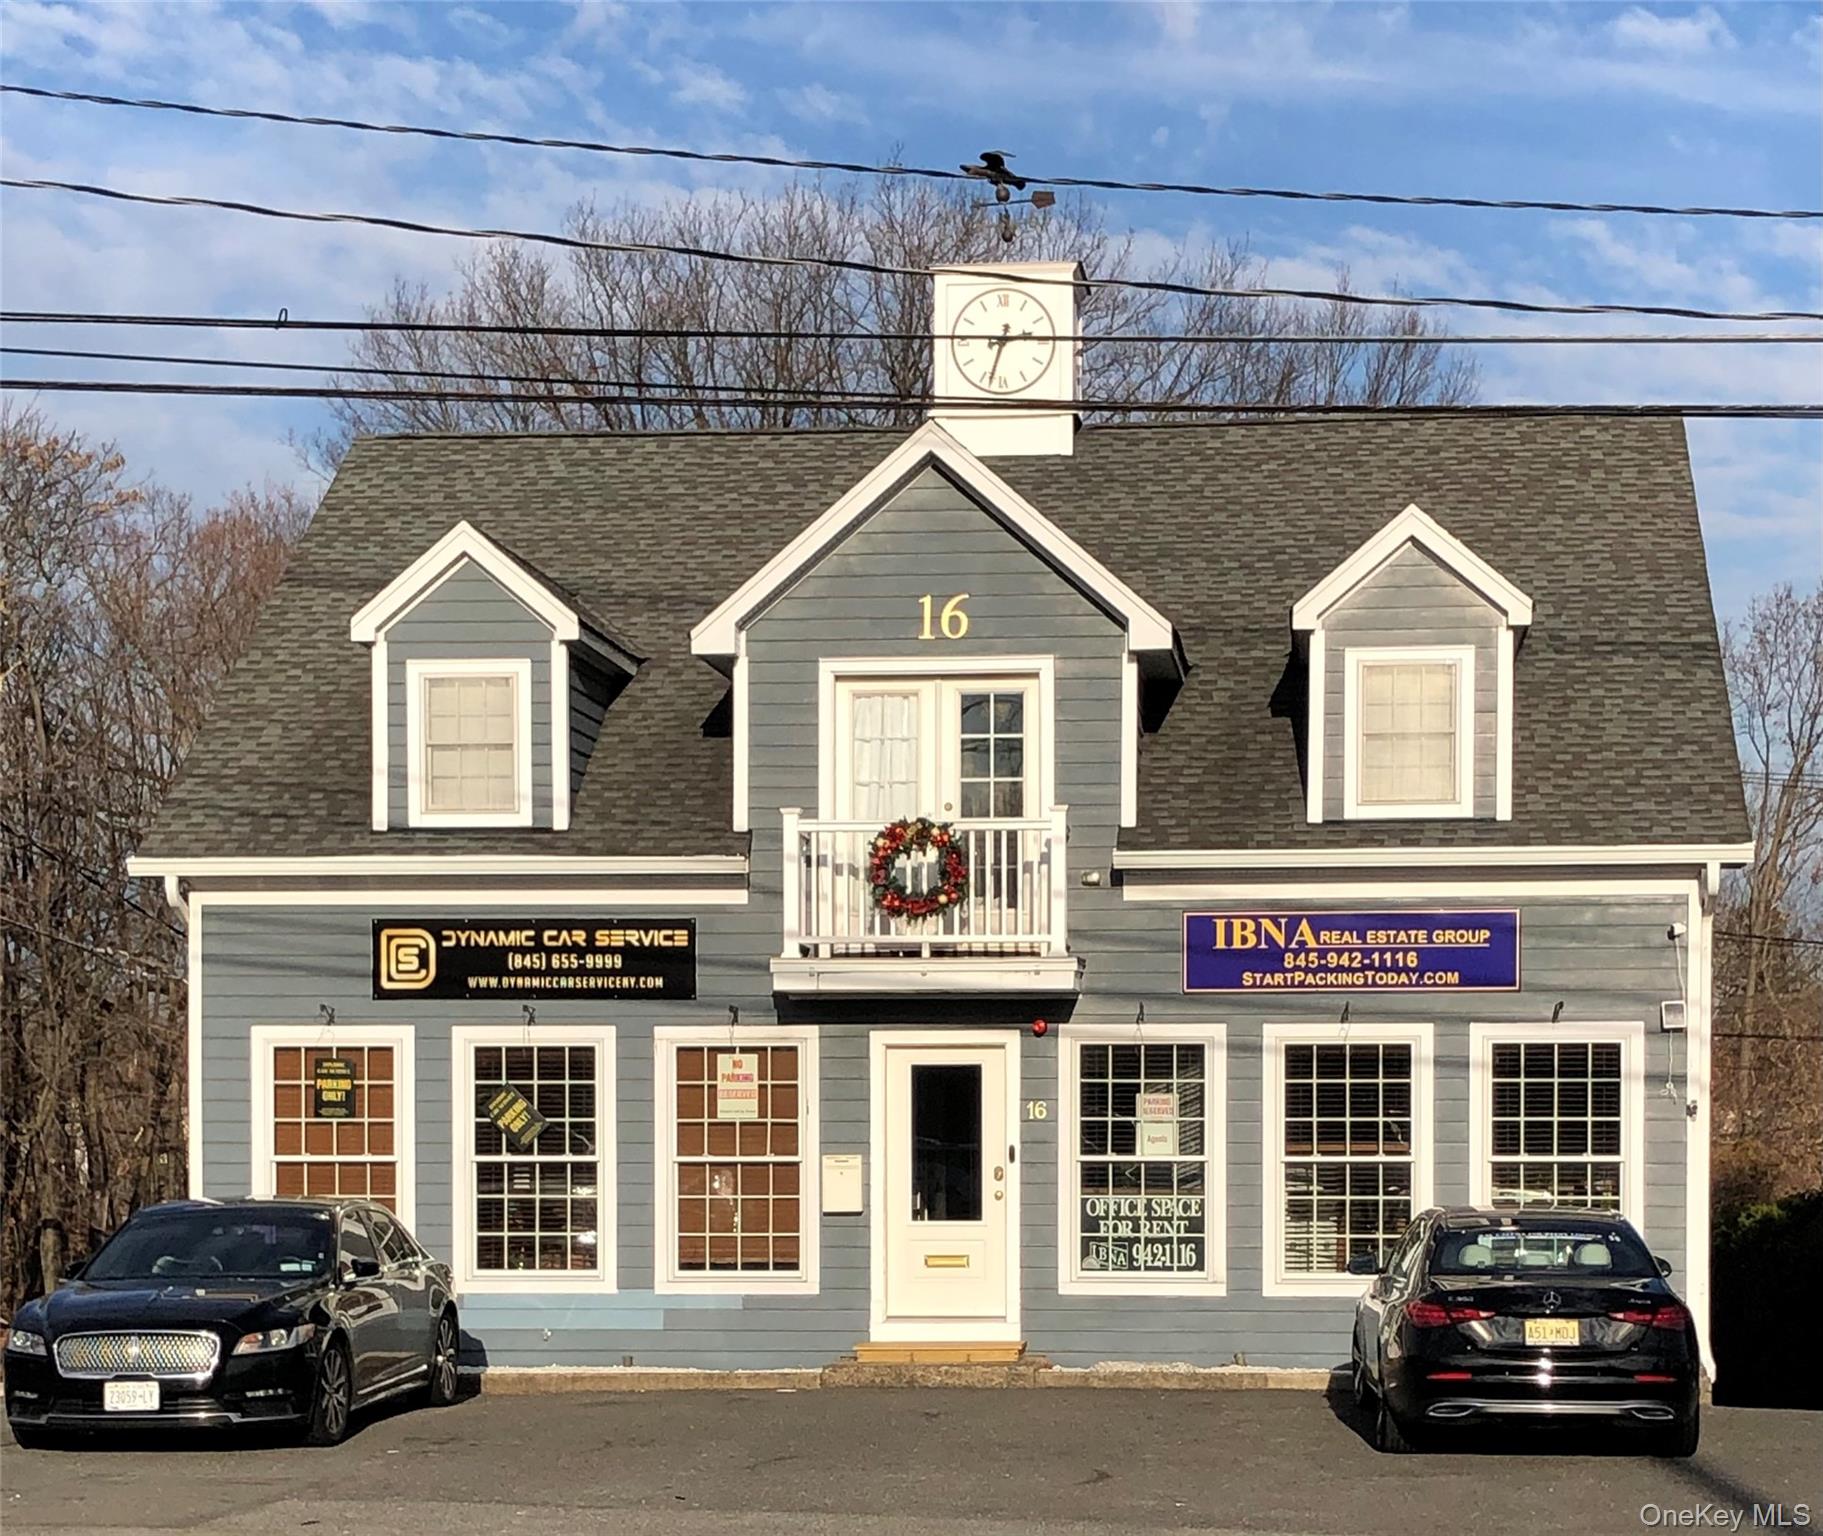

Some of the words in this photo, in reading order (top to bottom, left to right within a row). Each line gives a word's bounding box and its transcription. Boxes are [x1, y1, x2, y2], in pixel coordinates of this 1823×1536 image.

[918, 594, 970, 640] 16
[441, 929, 536, 947] DYNAMIC
[543, 929, 587, 947] CAR
[594, 929, 689, 947] SERVICE
[1211, 918, 1320, 950] IBNA
[1320, 931, 1358, 944] REAL
[1366, 930, 1426, 944] ESTATE
[1432, 929, 1491, 943] GROUP
[508, 952, 547, 971] (845)
[551, 953, 623, 969] 655-9999
[1284, 951, 1418, 969] 845-942-1116
[732, 1059, 743, 1069] NO
[721, 1072, 754, 1083] PARKING
[1026, 1100, 1048, 1120] 16
[1086, 1198, 1148, 1217] OFFICE
[1151, 1198, 1202, 1217] SPACE
[1098, 1219, 1134, 1238] FOR
[1138, 1219, 1190, 1238] RENT
